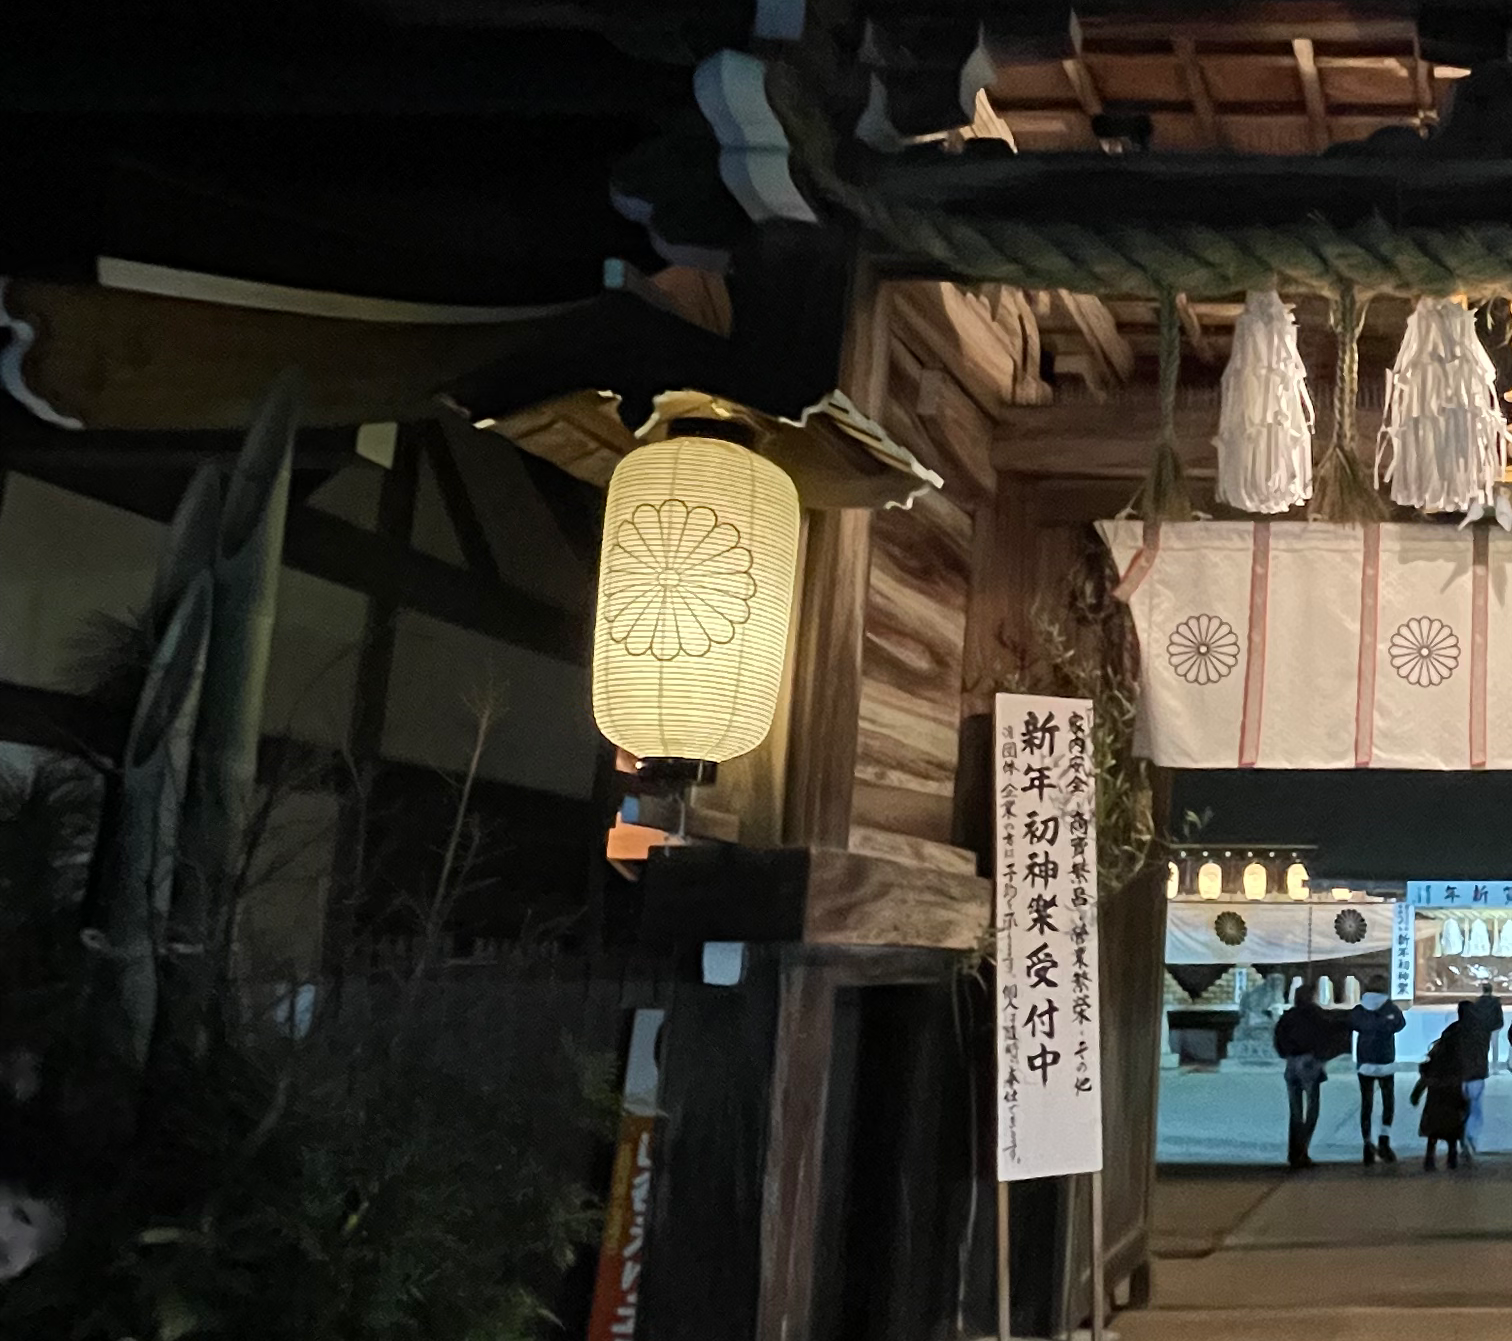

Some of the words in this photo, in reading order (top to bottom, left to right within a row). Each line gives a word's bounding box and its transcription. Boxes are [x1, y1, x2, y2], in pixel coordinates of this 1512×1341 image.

[1020, 710, 1060, 1088] 新年初神楽受付中
